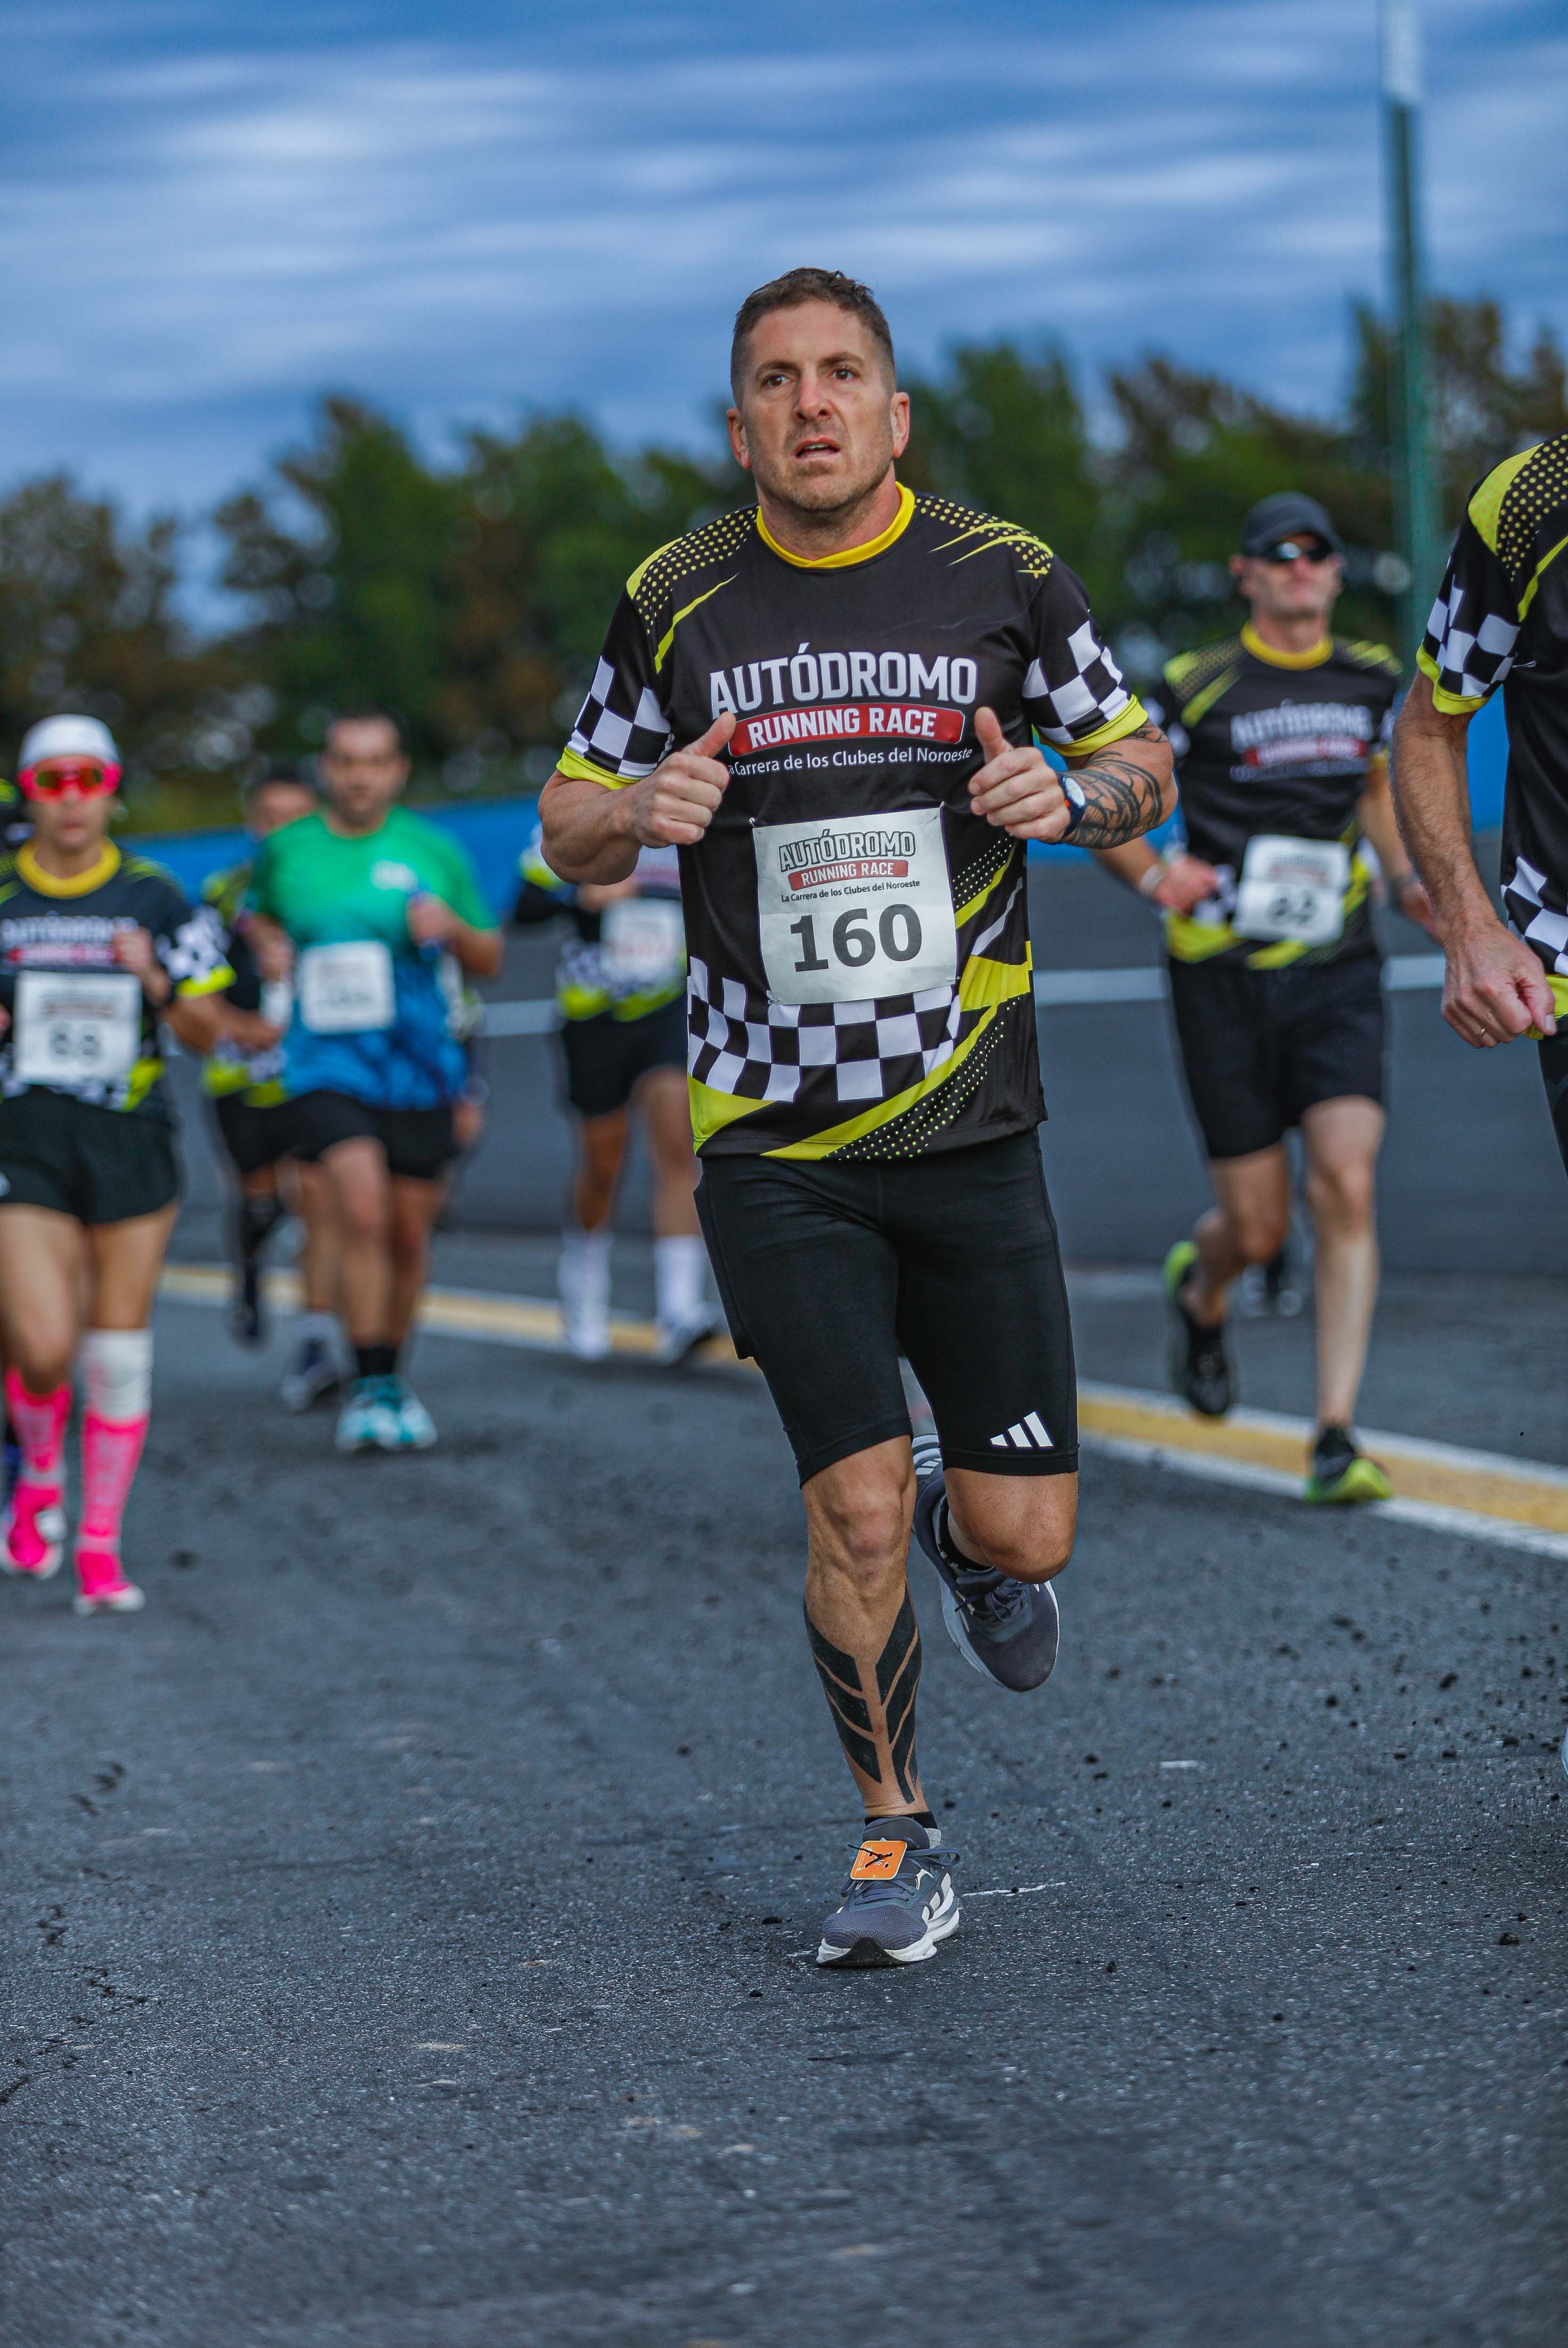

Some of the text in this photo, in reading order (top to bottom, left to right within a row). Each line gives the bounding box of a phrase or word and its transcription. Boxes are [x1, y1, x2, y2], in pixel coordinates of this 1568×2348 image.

[709, 641, 977, 719] AUTÓDROMO
[748, 706, 937, 749] RUNNING RACE
[735, 759, 780, 775] Carrera
[783, 754, 803, 769] de
[806, 753, 829, 769] los
[832, 750, 884, 766] Clubes
[888, 746, 912, 762] del
[916, 746, 973, 763] Noroeste
[778, 828, 916, 872] AUTÓDROMO
[791, 892, 818, 901] Carrera
[818, 890, 830, 898] de
[830, 888, 842, 897] los
[843, 885, 871, 895] Clubes
[872, 883, 885, 891] del
[885, 880, 921, 890] Noroeste
[800, 862, 895, 887] RUNNING RACE
[790, 904, 922, 972] 160
